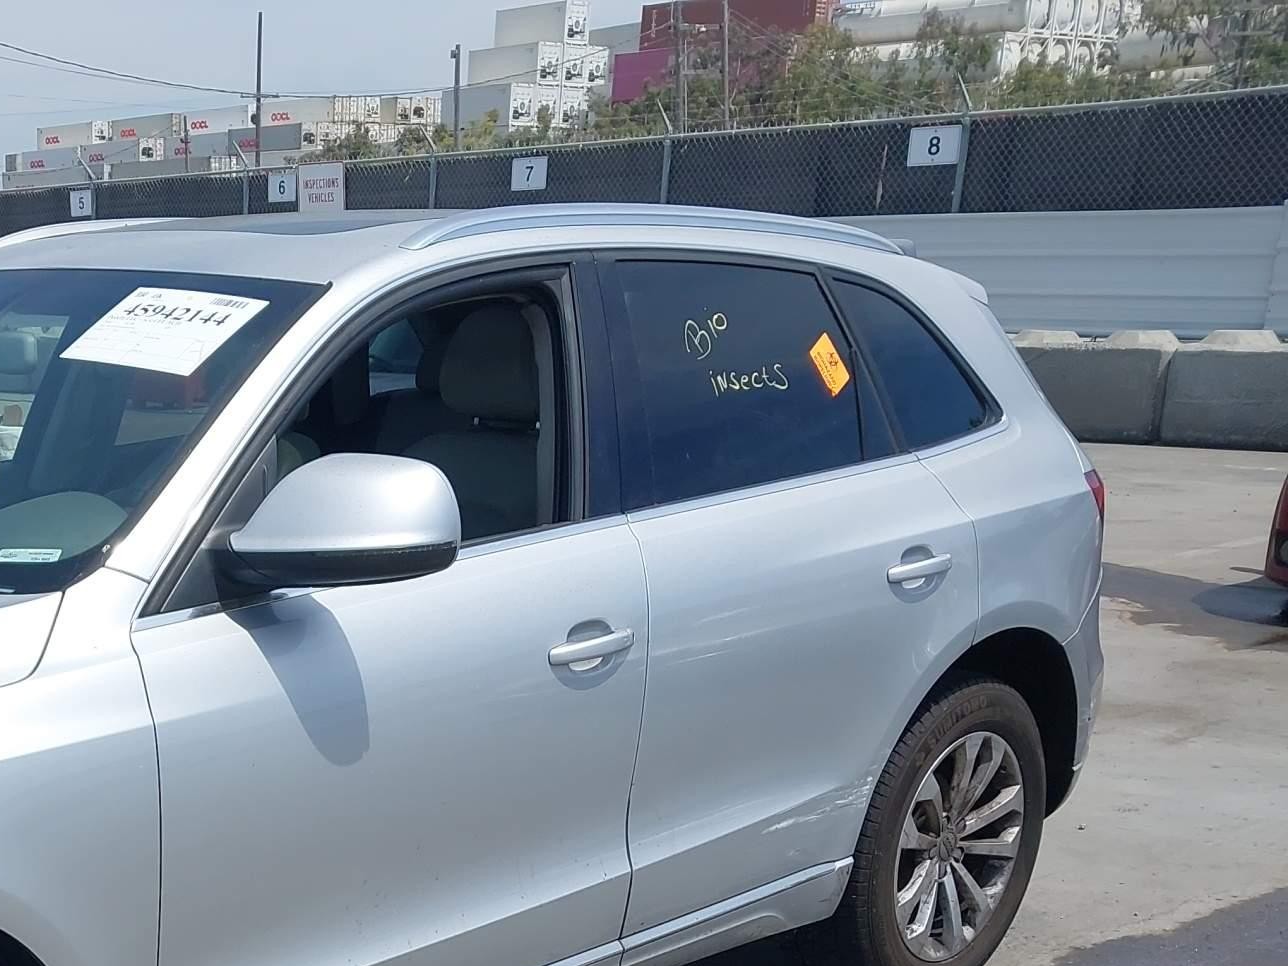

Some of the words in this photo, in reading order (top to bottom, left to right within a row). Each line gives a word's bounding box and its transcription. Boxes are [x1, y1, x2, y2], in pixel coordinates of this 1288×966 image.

[271, 112, 290, 122] OOCL
[191, 120, 208, 130] OOCL
[120, 128, 136, 138] OOCL
[45, 136, 60, 145] OOCL
[927, 136, 941, 156] 8
[30, 159, 45, 169] OOCL
[88, 153, 105, 163] OOCL
[525, 165, 535, 182] 7
[278, 180, 286, 195] 6
[303, 177, 339, 190] INSPECTIONS
[78, 197, 85, 209] 5
[307, 191, 334, 204] VEHICLES
[123, 302, 233, 327] 45942144
[926, 695, 988, 747] SUMITOMO
